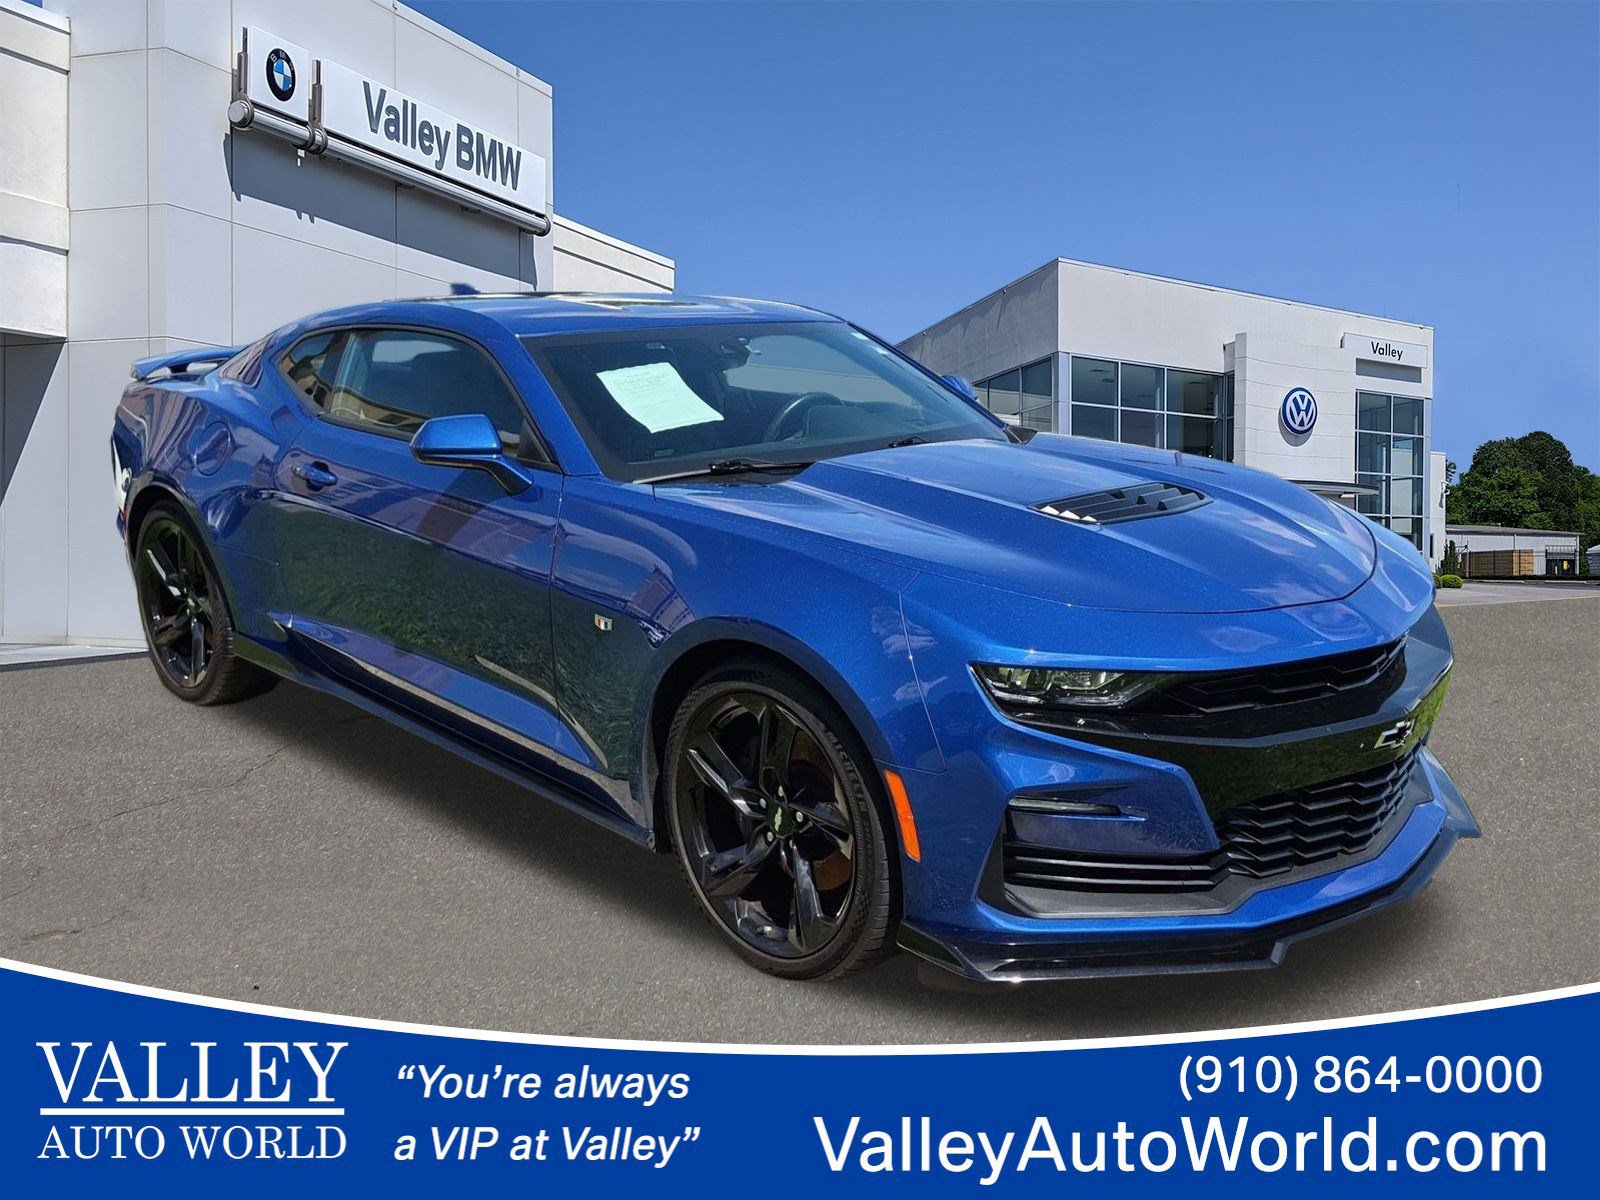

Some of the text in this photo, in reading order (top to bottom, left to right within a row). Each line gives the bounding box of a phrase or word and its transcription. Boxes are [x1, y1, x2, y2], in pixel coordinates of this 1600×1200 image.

[362, 80, 522, 191] Valley BMW
[1371, 341, 1403, 361] Valley
[826, 731, 868, 812] MICHELIN
